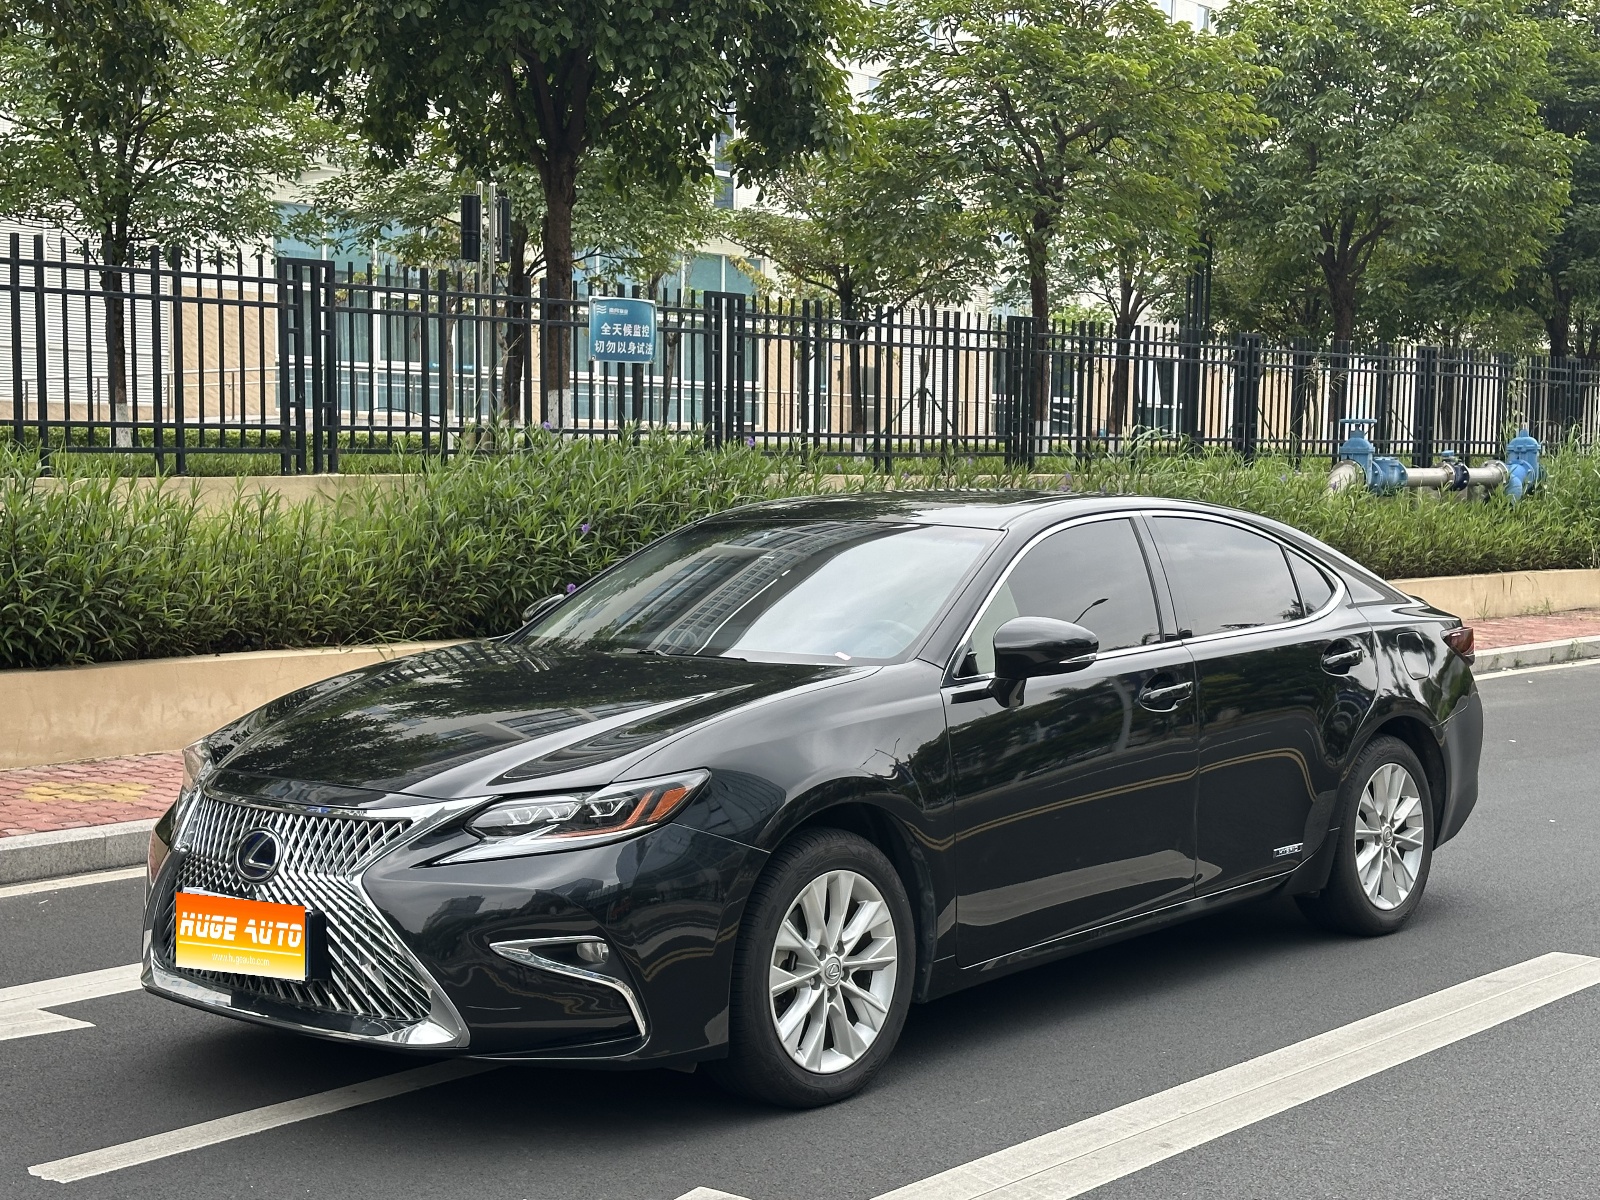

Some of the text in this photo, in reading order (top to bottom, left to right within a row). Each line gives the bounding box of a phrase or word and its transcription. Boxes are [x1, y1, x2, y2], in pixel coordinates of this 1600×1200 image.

[600, 322, 650, 338] 全天候监控
[594, 340, 653, 355] 切勿以身试法
